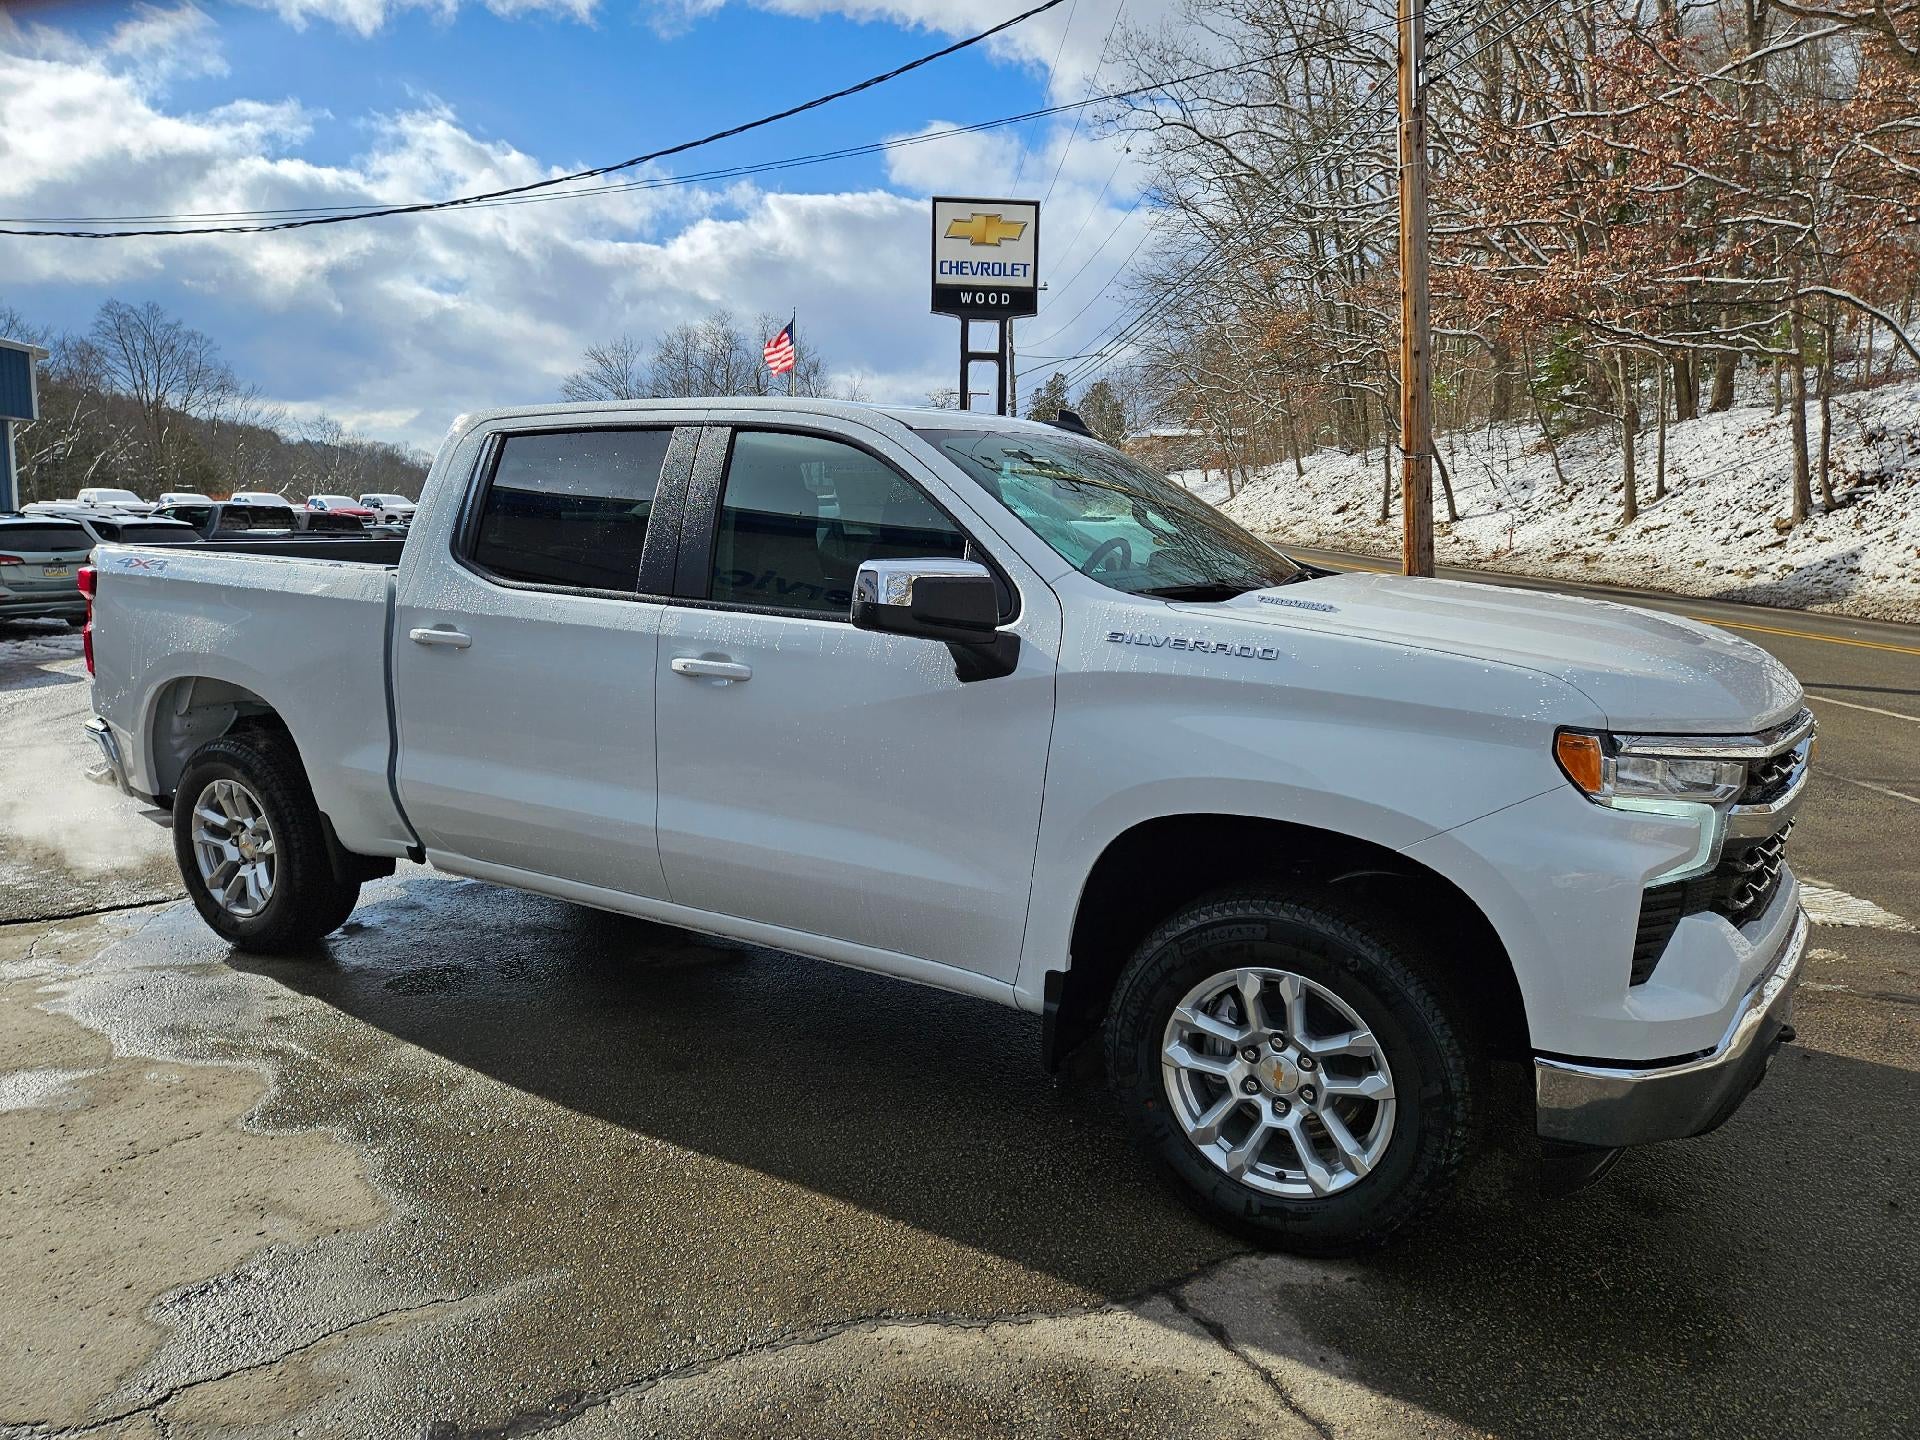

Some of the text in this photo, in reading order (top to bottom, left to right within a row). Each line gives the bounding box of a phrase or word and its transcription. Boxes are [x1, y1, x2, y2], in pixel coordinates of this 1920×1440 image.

[939, 260, 1031, 278] CHEVROLET
[960, 291, 1010, 305] WOOD
[1105, 630, 1280, 661] SILVERADO
